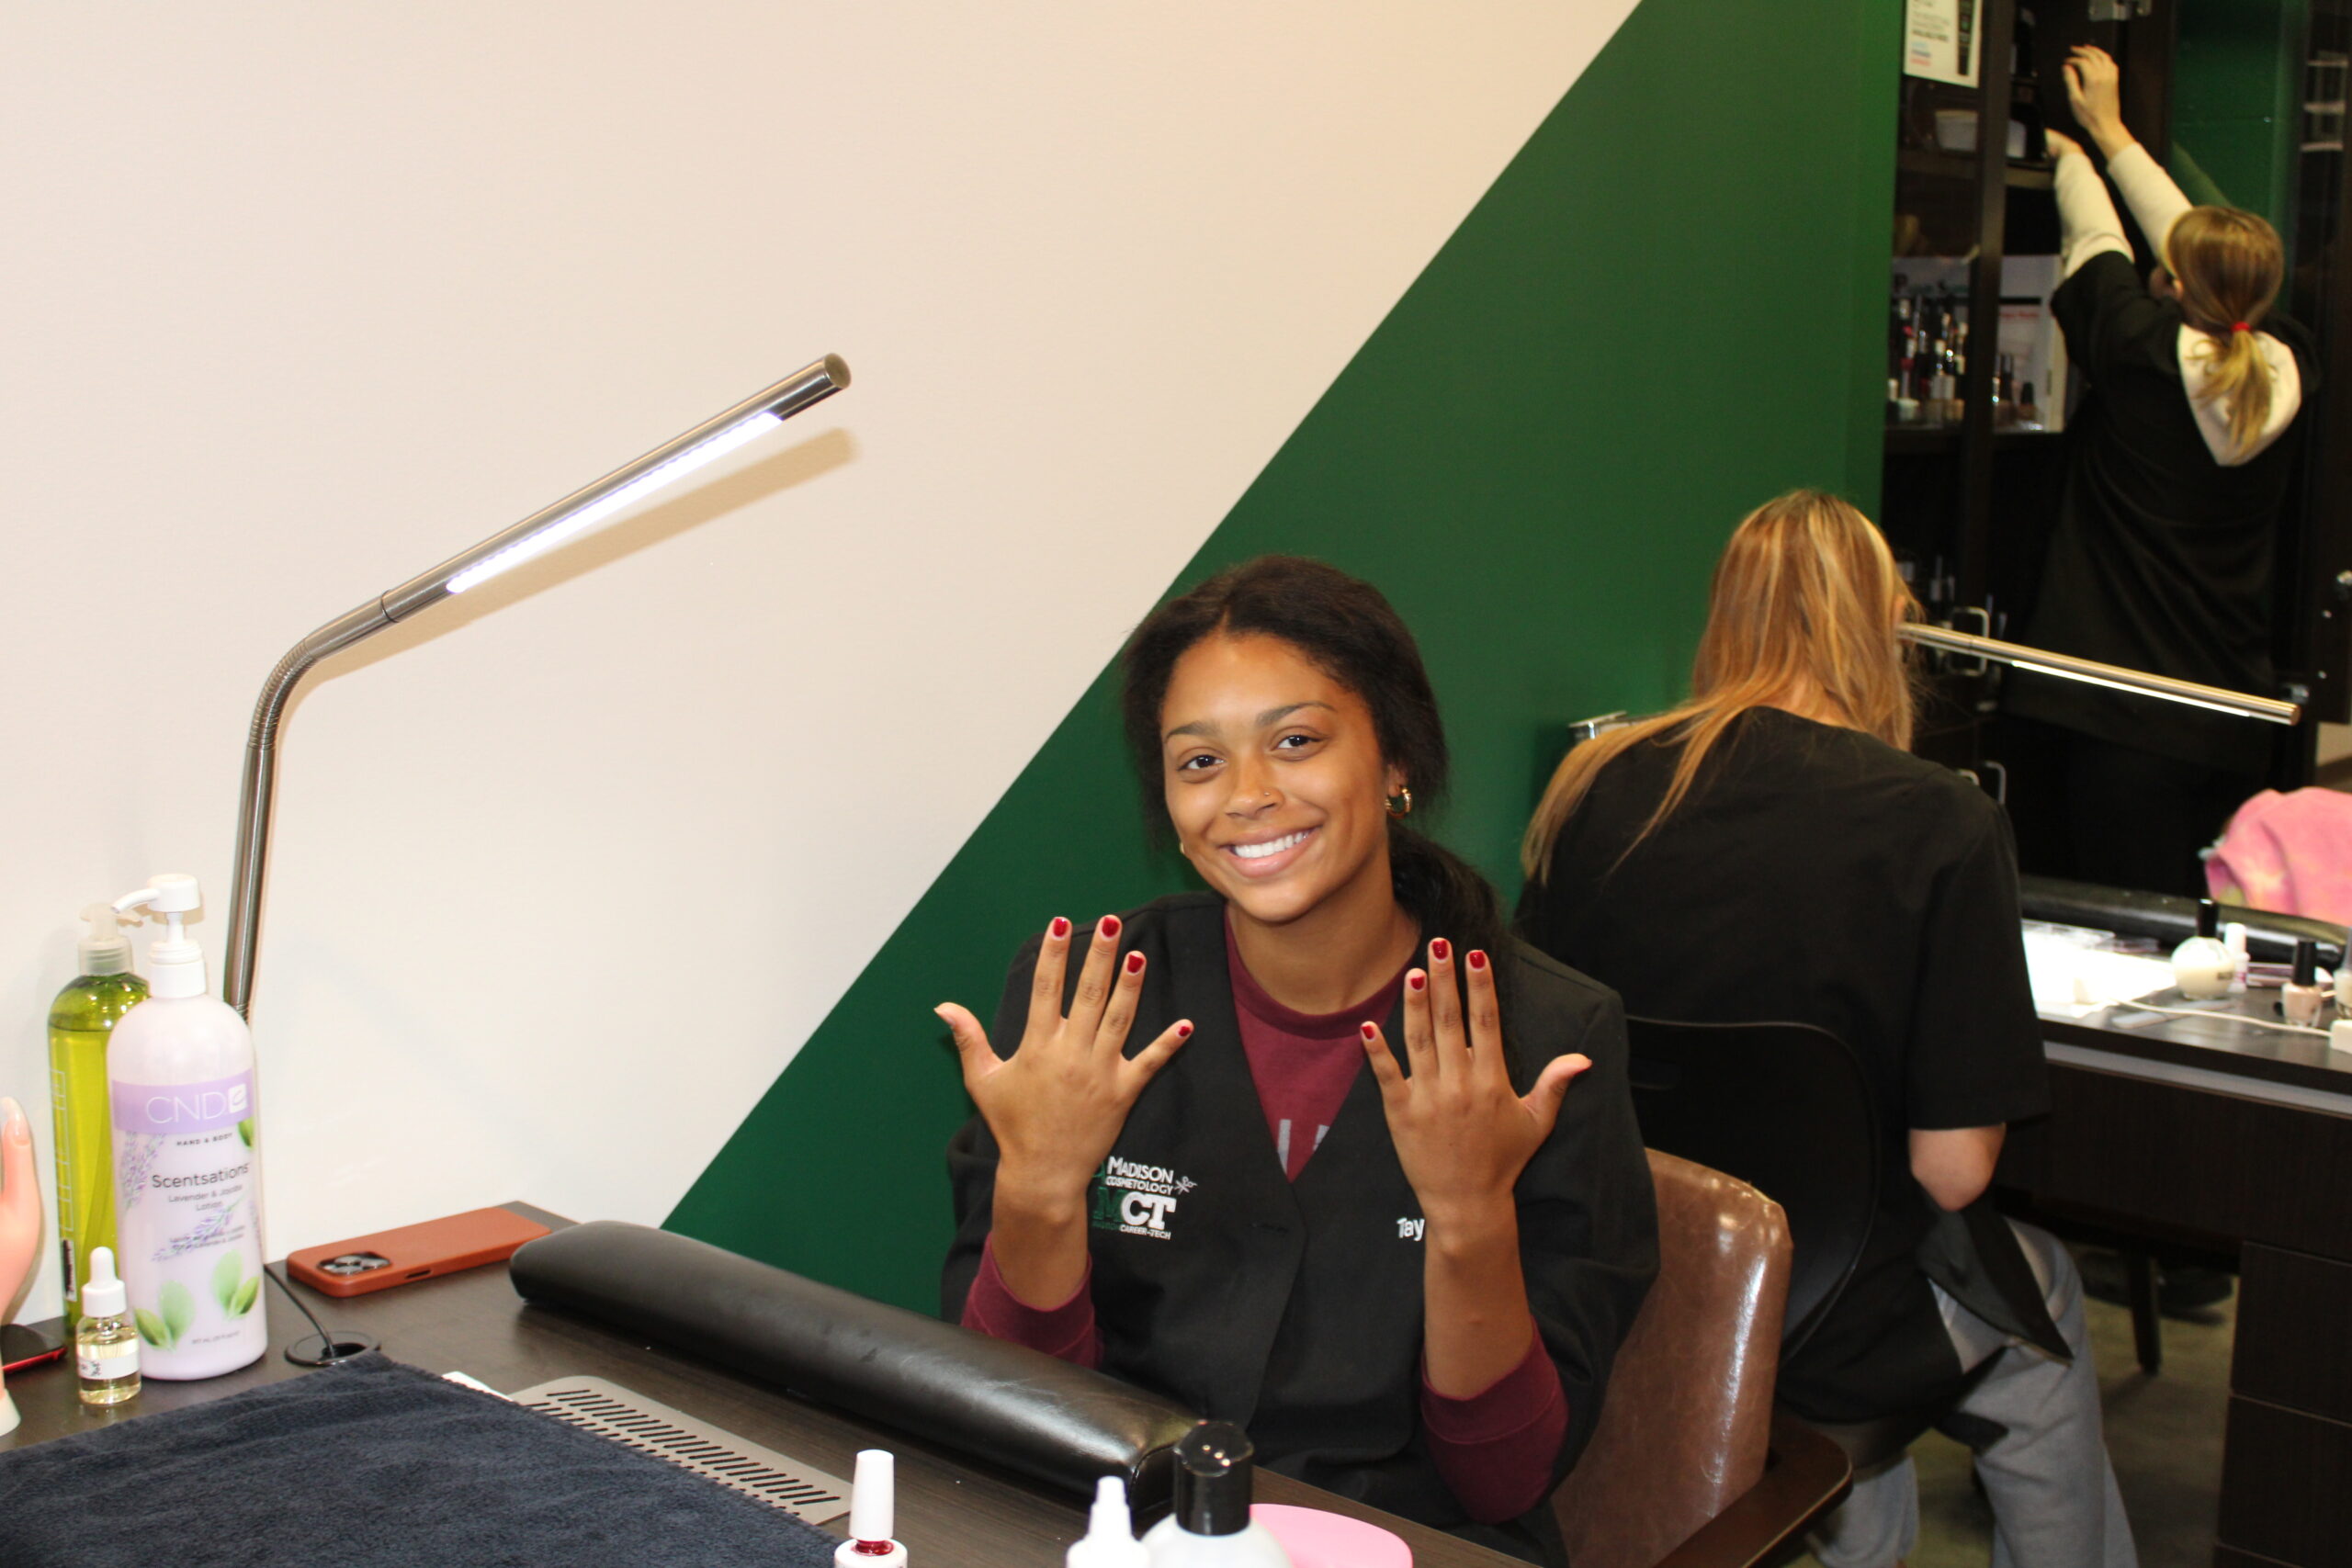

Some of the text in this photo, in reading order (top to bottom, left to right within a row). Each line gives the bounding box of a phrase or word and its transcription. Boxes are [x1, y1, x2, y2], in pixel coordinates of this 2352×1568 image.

[146, 1091, 227, 1124] CND
[152, 1165, 249, 1188] Scentsations
[1106, 1156, 1174, 1184] MADISON
[1105, 1176, 1174, 1195] COSMETOLOGY
[1120, 1224, 1171, 1240] CAREER-TECH
[1396, 1217, 1425, 1241] Tay
